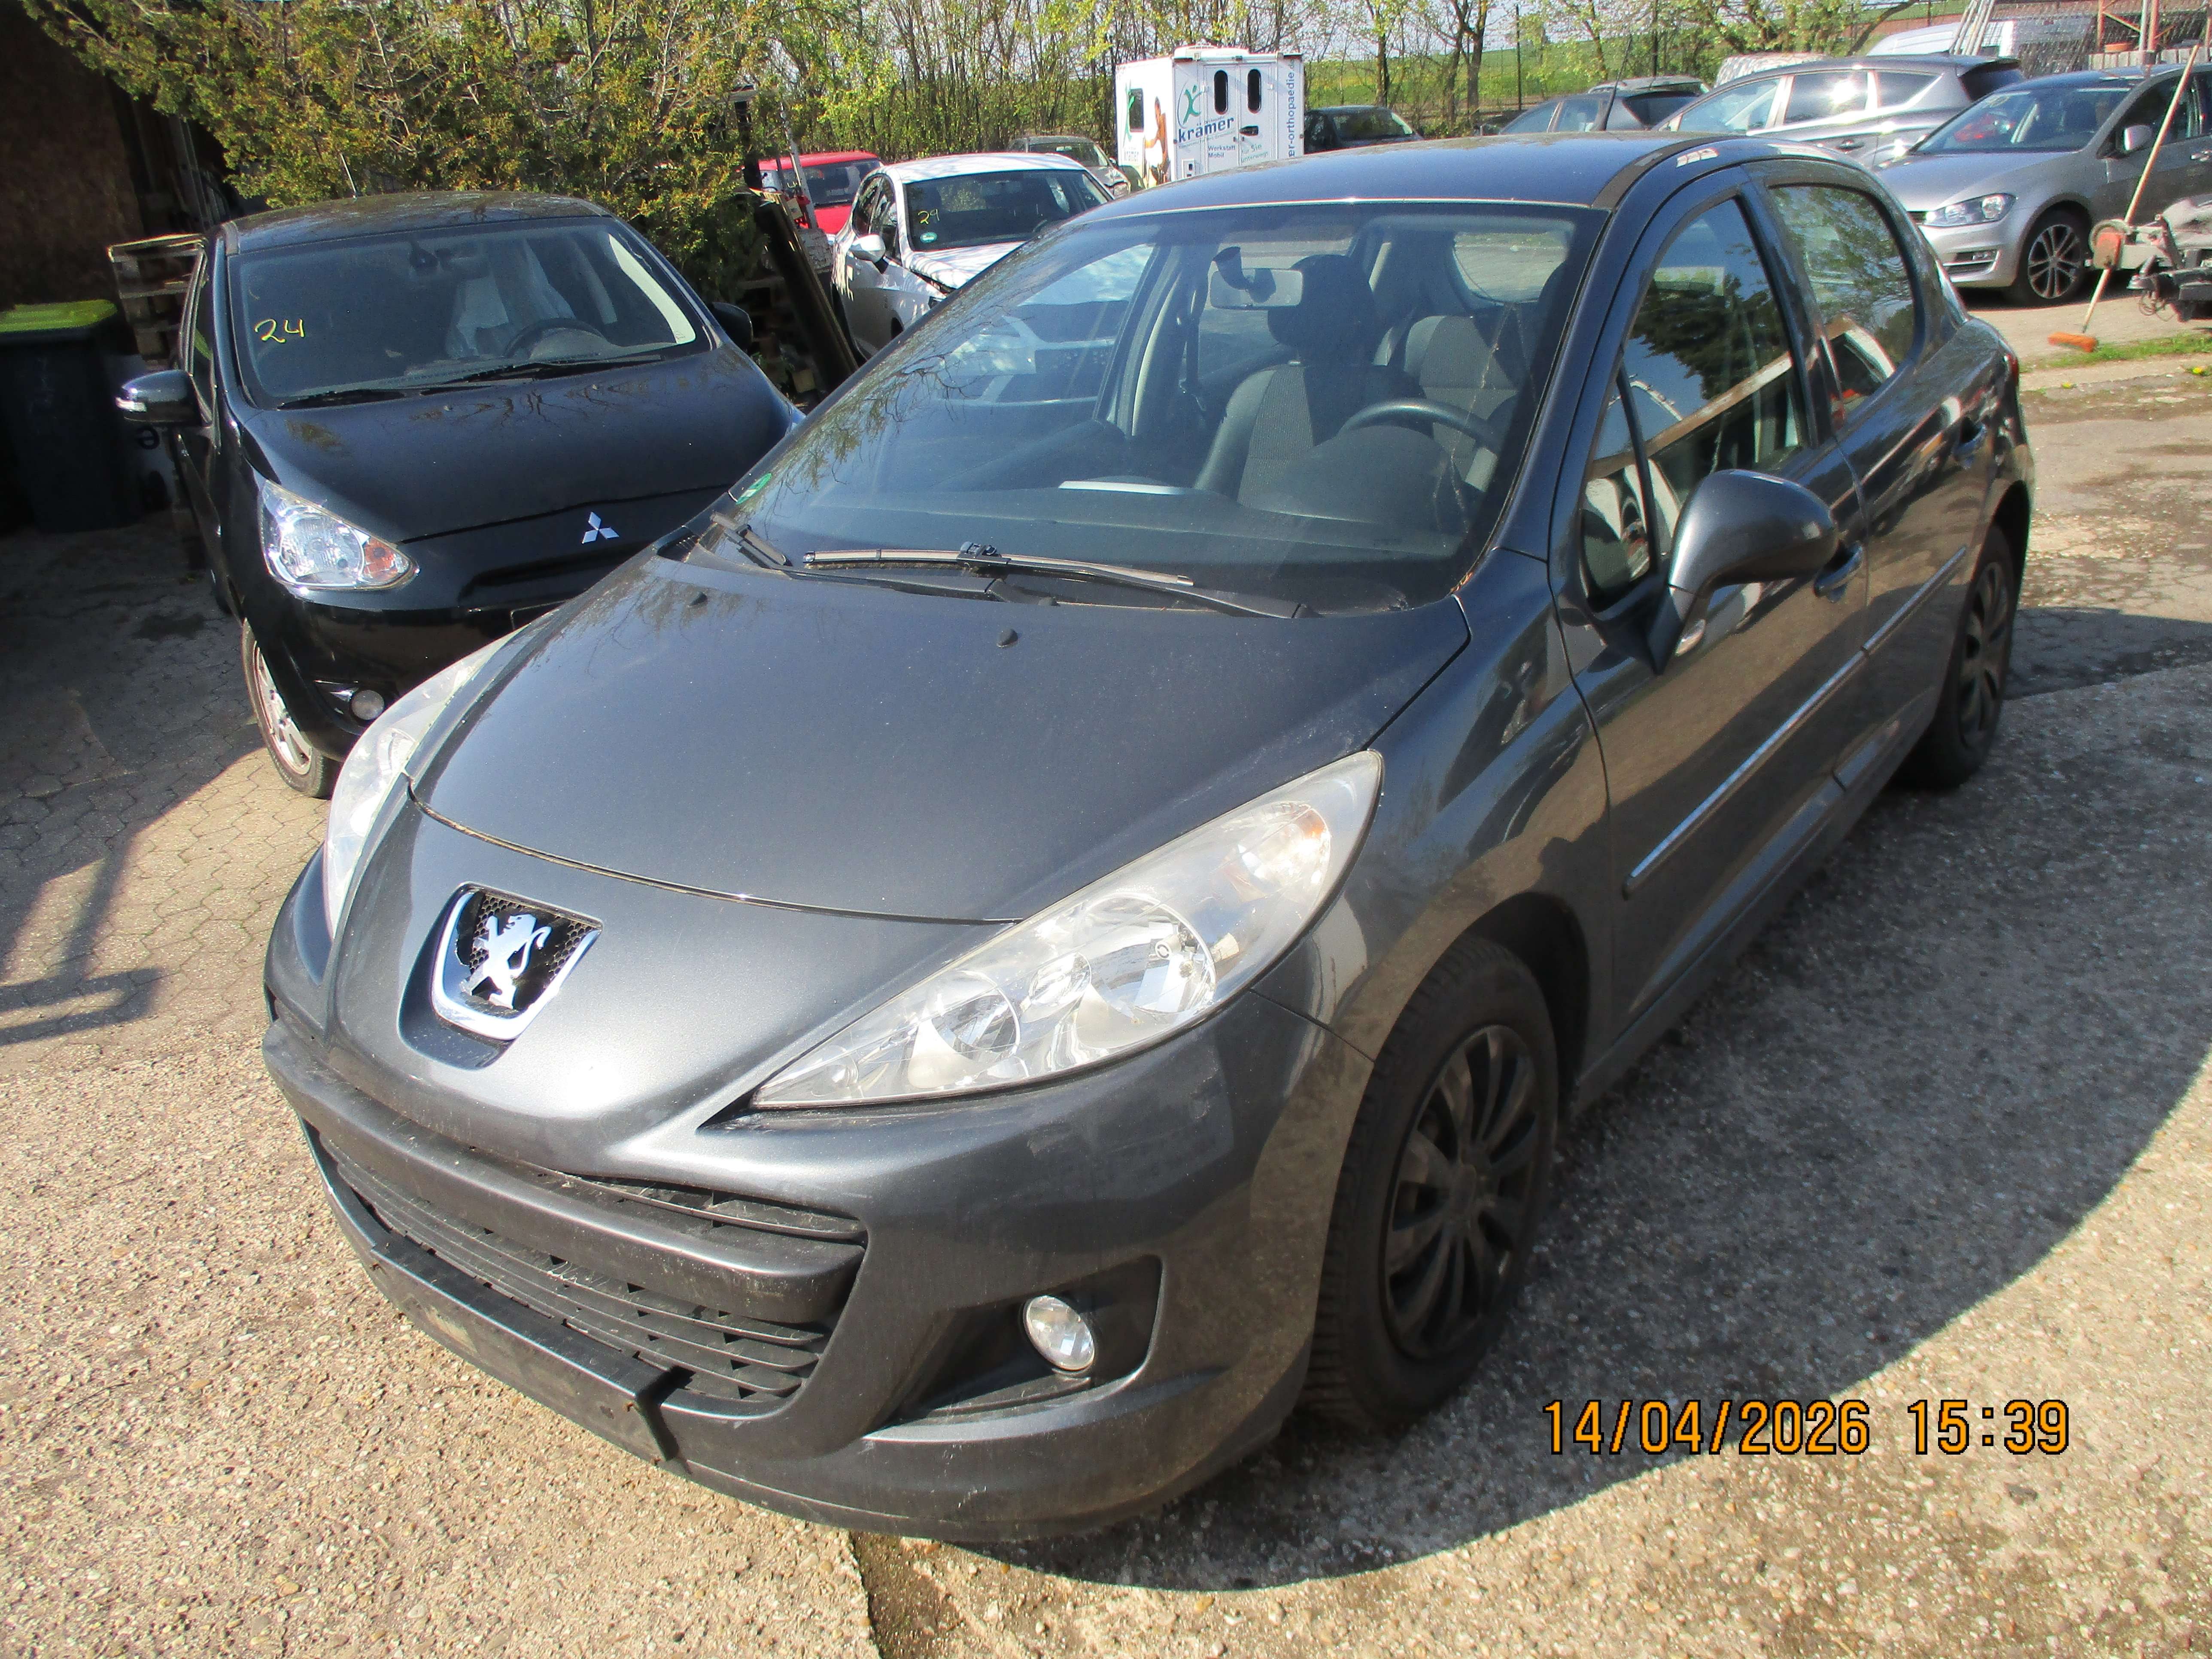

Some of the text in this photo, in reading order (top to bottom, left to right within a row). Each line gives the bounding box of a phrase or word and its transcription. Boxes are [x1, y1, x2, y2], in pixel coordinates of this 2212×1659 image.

[1179, 117, 1234, 143] krämer
[918, 209, 940, 224] 29
[254, 319, 304, 343] 24
